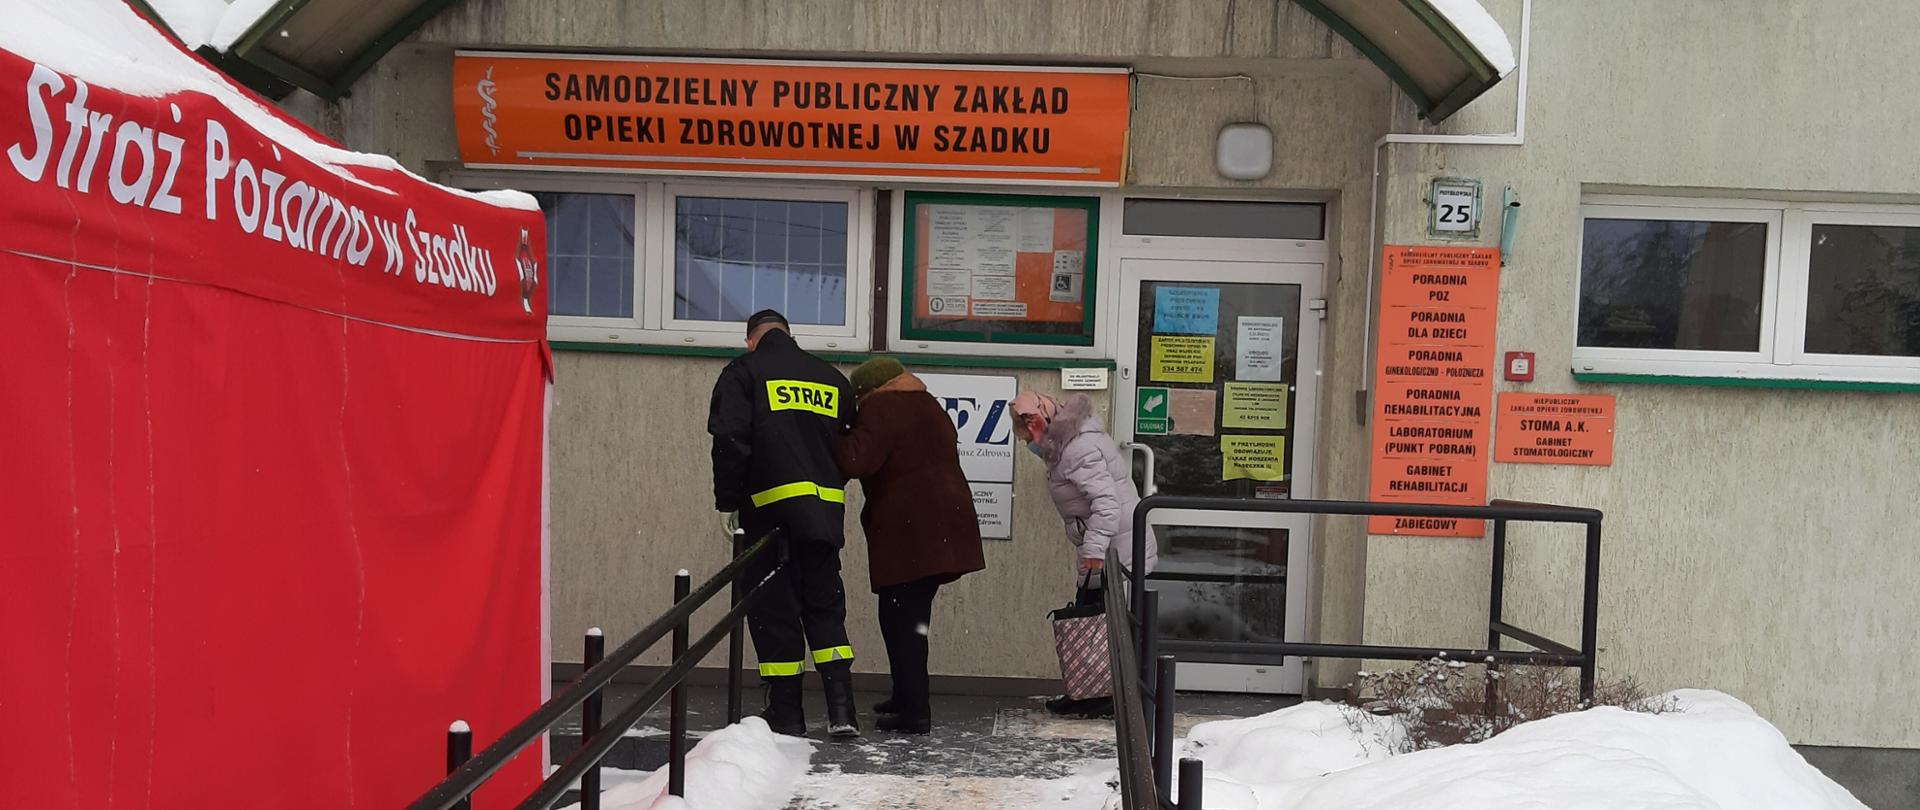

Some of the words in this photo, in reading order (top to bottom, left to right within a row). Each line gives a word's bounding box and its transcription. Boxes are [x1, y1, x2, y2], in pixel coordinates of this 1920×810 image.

[544, 72, 758, 108] SAMODZIELNY
[773, 83, 939, 113] PUBLICZNY
[953, 85, 1070, 115] ZAKŁAD
[564, 113, 666, 144] OPIEKI
[679, 118, 881, 151] ZDROWOTNEJ
[894, 124, 922, 152] W
[933, 125, 1051, 155] SZADKU
[7, 62, 186, 215] Straż
[205, 118, 374, 267] Pożarna
[374, 214, 404, 276] w
[404, 207, 497, 297] Szadku
[1439, 204, 1470, 224] 25
[1412, 273, 1468, 286] PORADNIA
[1429, 290, 1450, 302] POZ
[1410, 311, 1466, 324] PORADNIA
[1408, 327, 1429, 339] DLA
[1432, 327, 1468, 340] DZIECI
[1408, 350, 1463, 362] PORADNIA
[1385, 365, 1439, 378] GINEKOLOGICZNO
[1406, 388, 1461, 401] PORADNIA
[1533, 398, 1580, 406] NIEPUBLICZNY
[1519, 419, 1561, 432] STOMA
[1565, 420, 1590, 433] A.K.
[1389, 426, 1474, 440] LABORATORIUM
[1536, 437, 1573, 447] GABINET
[976, 447, 1011, 458] Zdrowia
[1384, 442, 1425, 456] (PUNKT
[1428, 442, 1477, 457] POBRAŃ)
[1512, 447, 1595, 459] STOMATOLOGICZNY
[1406, 465, 1452, 478] GABINET
[1388, 480, 1468, 494] REHABILITACJI
[1394, 518, 1458, 531] ZABIEGOWY
